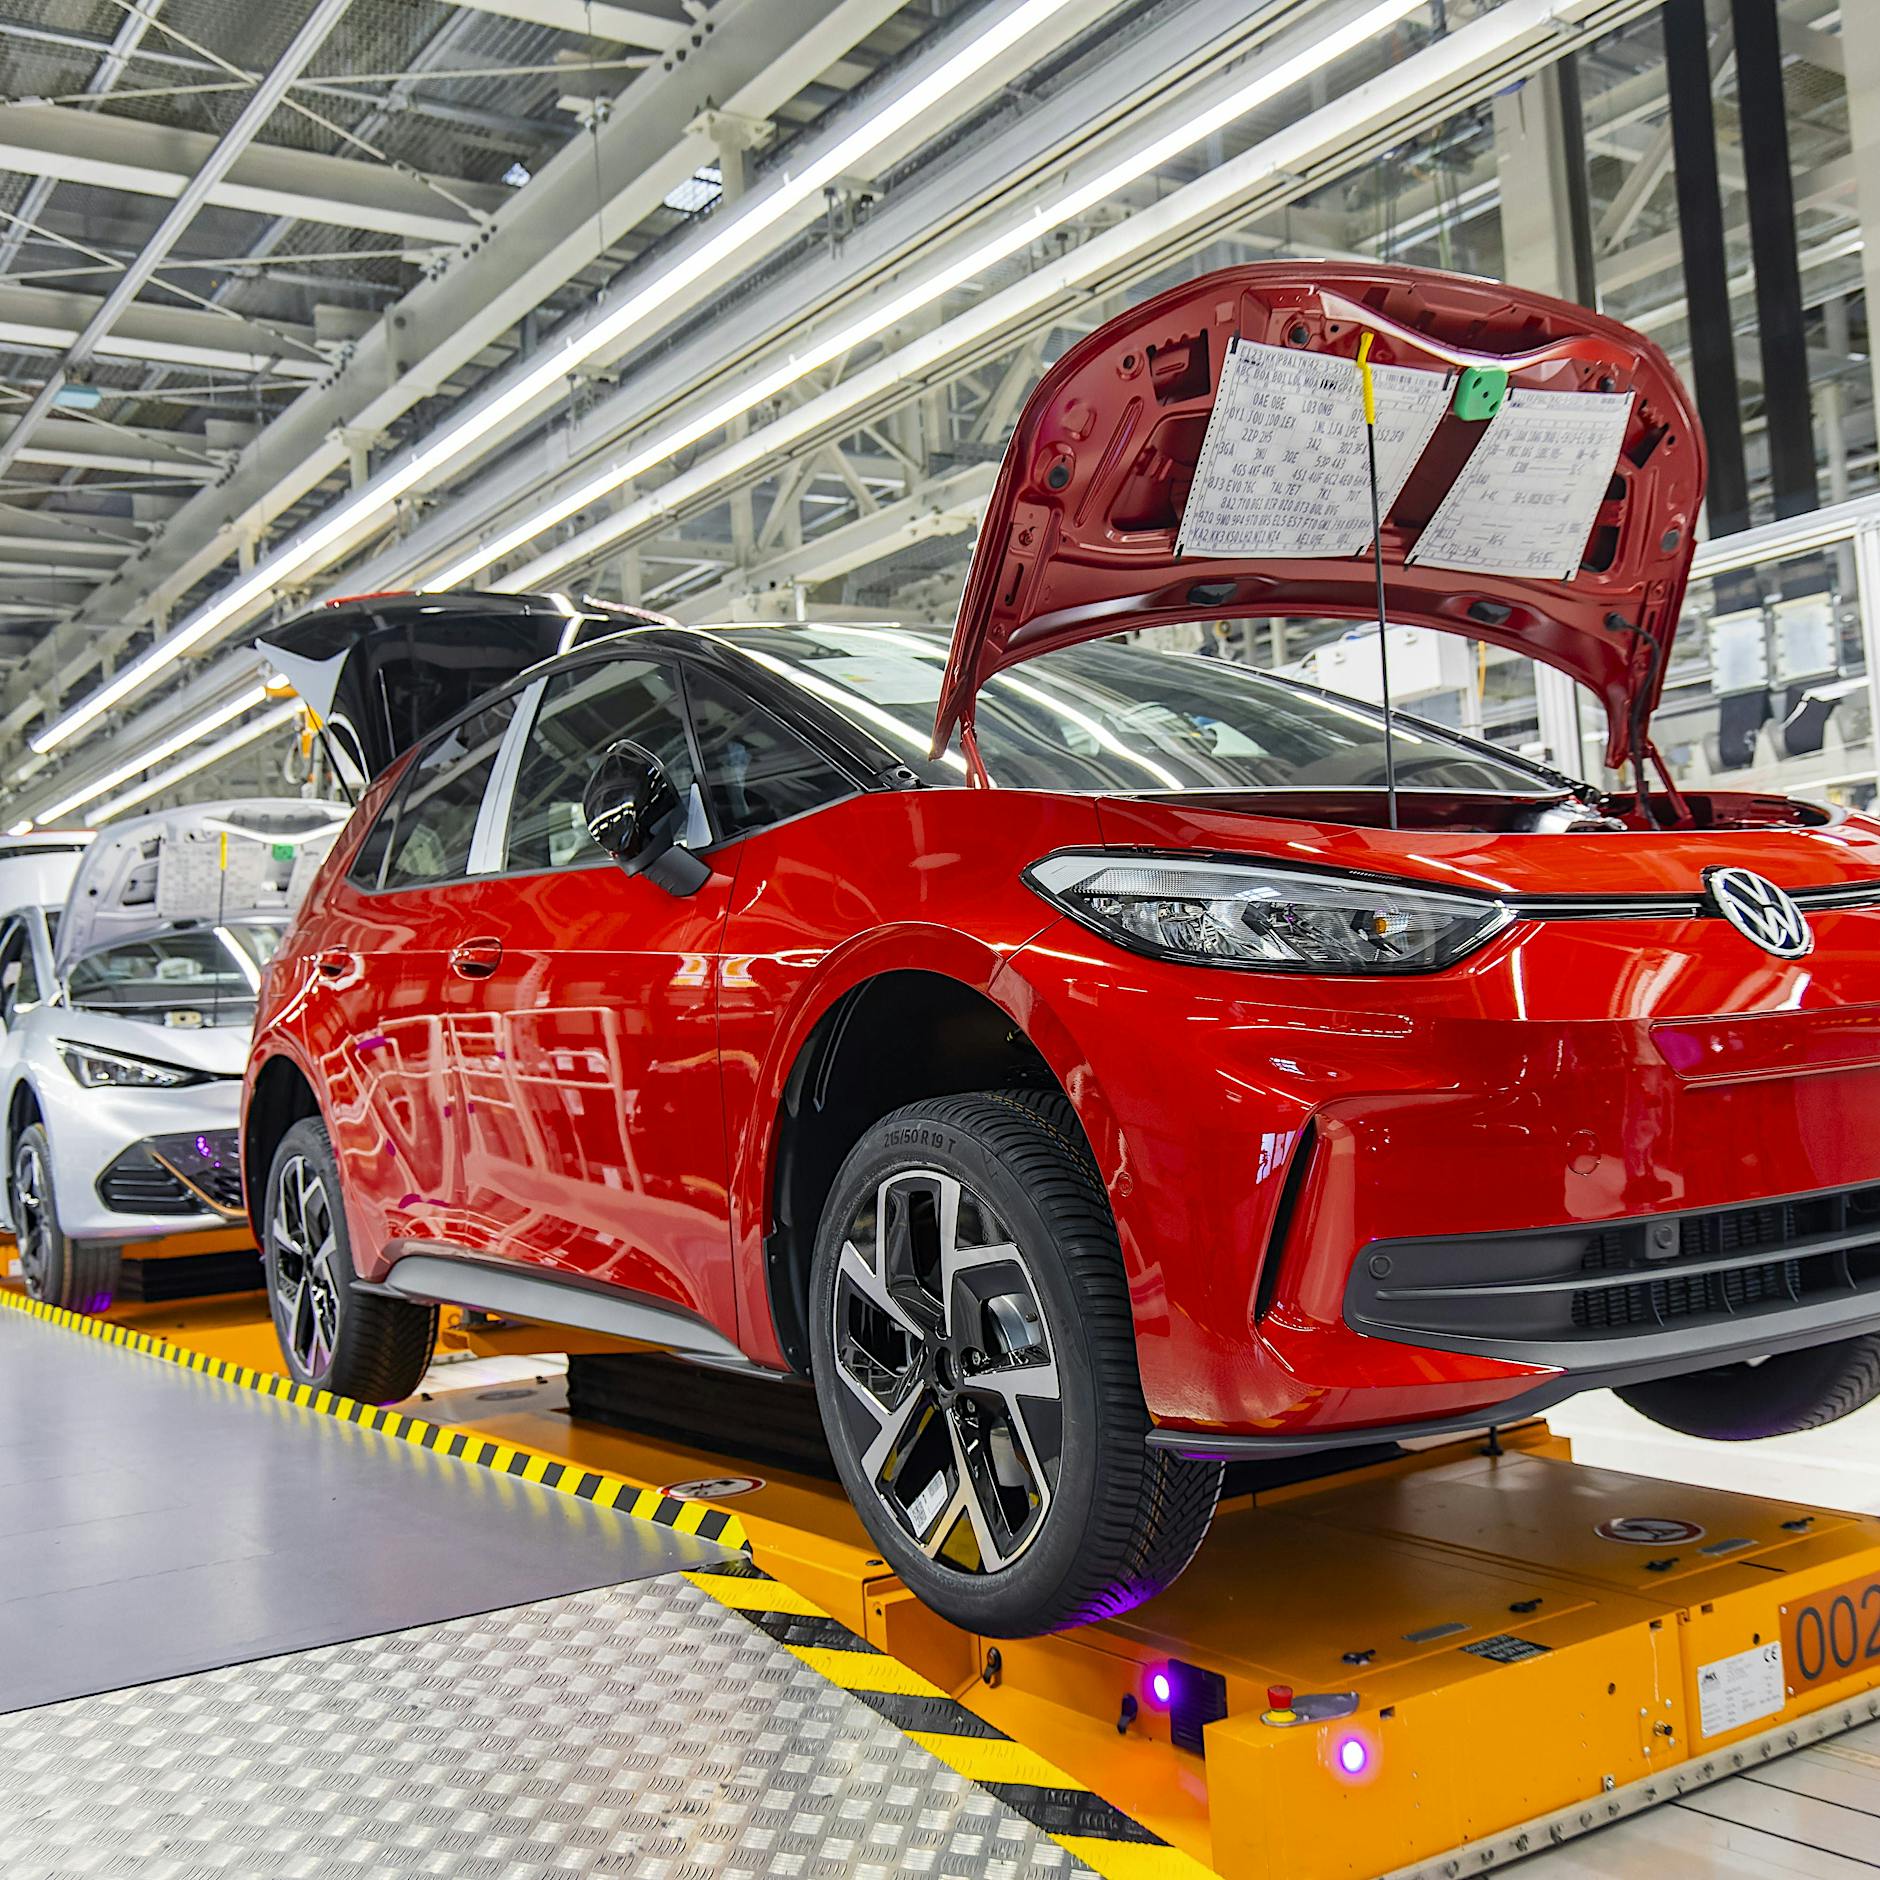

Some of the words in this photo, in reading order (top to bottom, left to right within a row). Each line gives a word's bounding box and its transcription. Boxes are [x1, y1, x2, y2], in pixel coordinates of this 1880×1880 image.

[884, 1129, 918, 1148] 215/50
[921, 1130, 929, 1145] R
[931, 1132, 943, 1148] 19
[948, 1138, 957, 1153] T
[1796, 1584, 1880, 1680] 002
